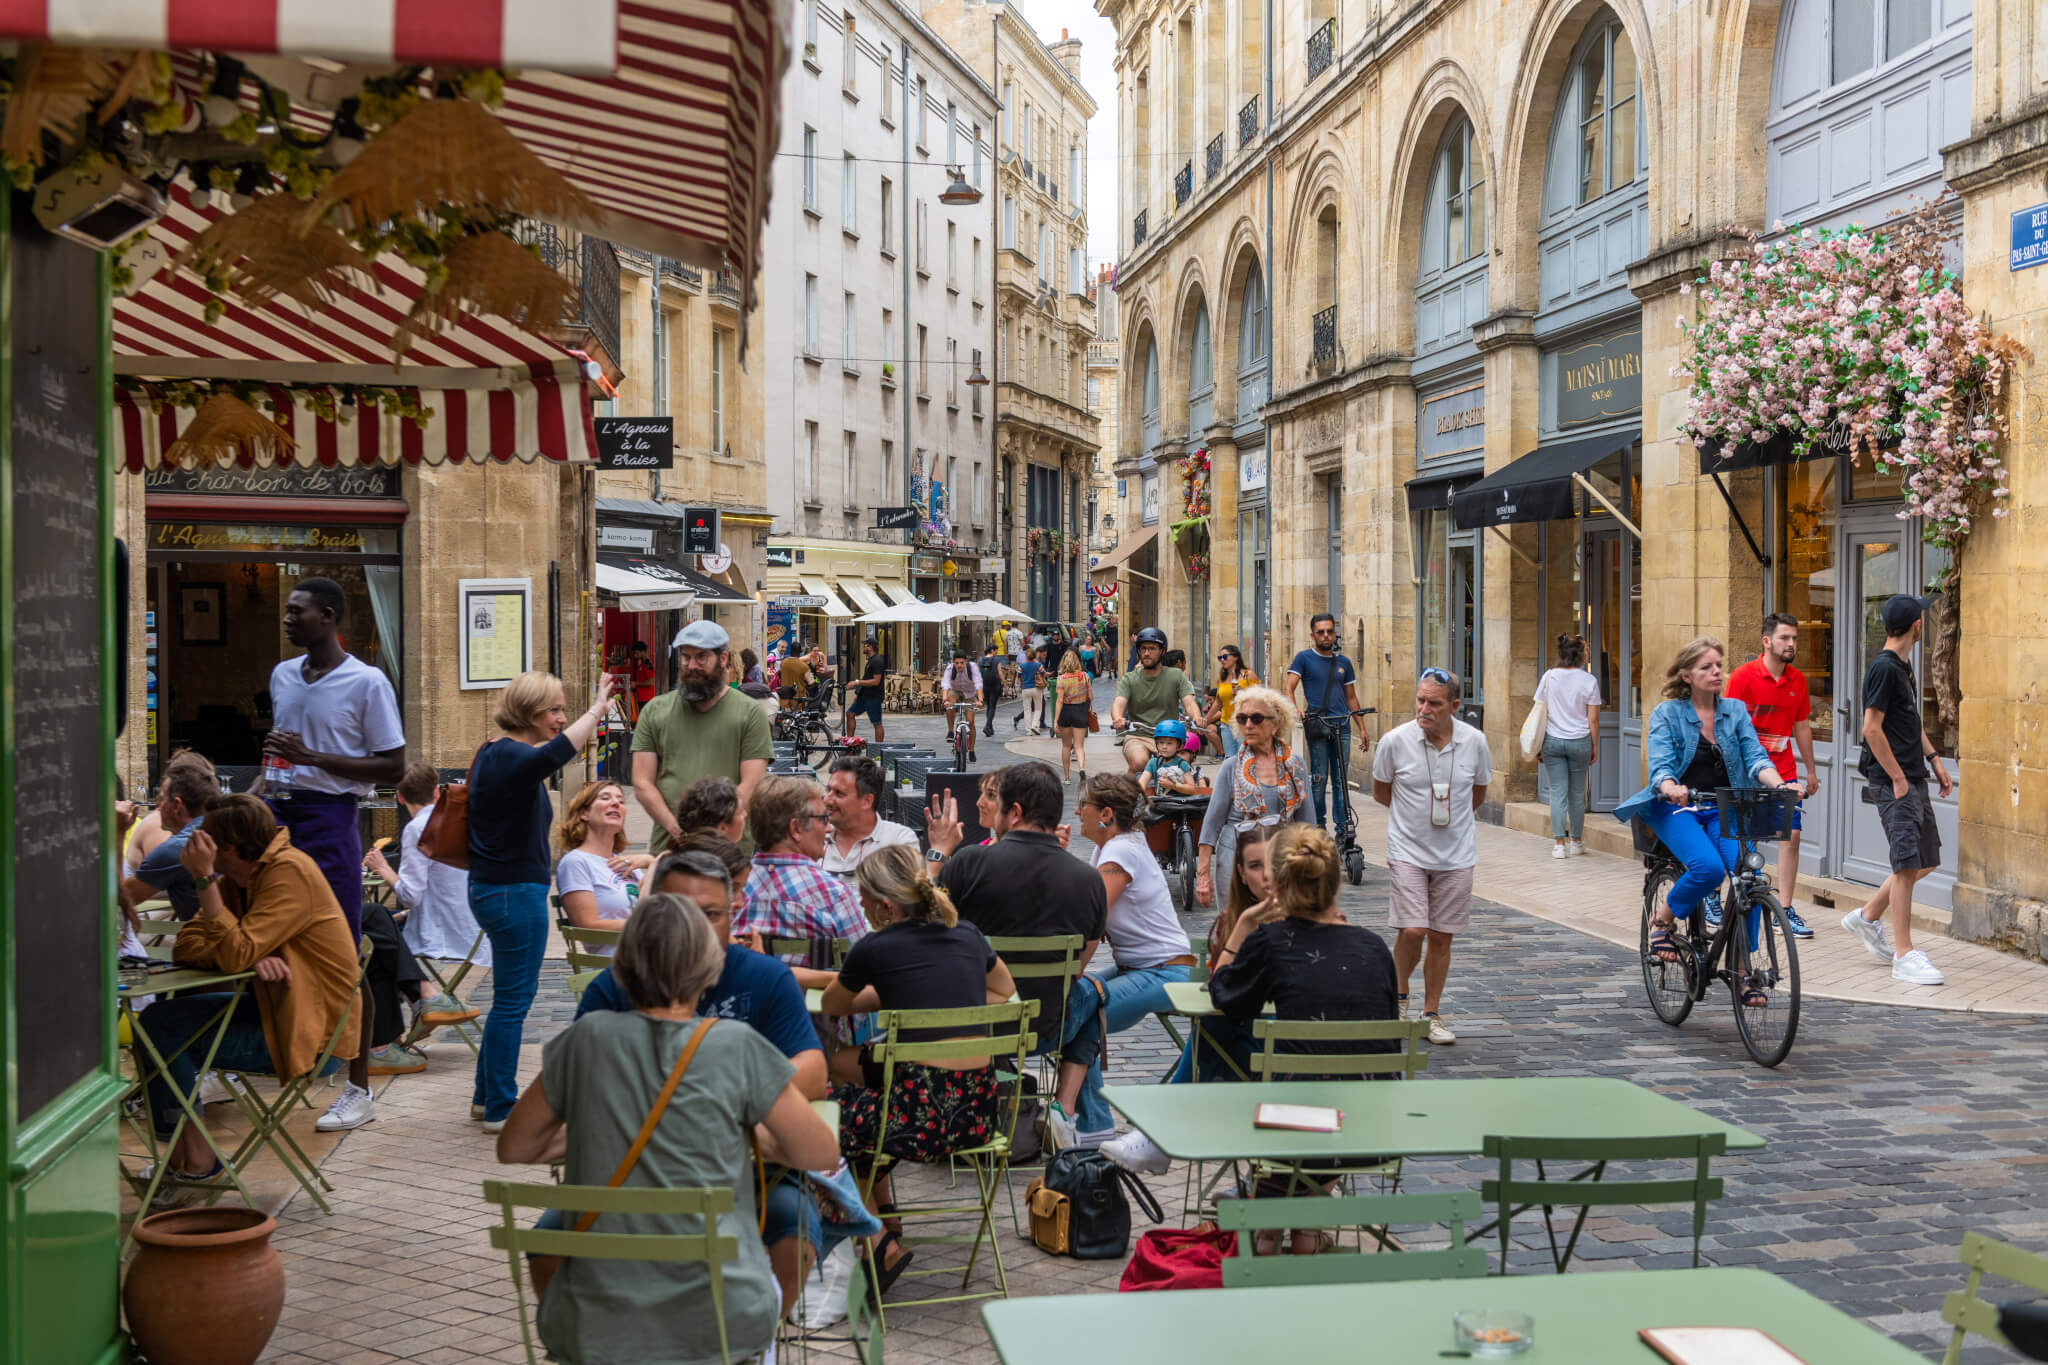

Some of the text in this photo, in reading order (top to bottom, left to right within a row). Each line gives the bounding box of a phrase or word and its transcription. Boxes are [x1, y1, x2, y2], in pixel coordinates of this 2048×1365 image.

[2032, 211, 2048, 228] RUE
[2034, 229, 2045, 240] DU
[1608, 352, 1641, 382] MARA
[601, 422, 669, 438] L'Agneau
[1436, 410, 1463, 435] BLACK
[621, 437, 650, 450] à la
[612, 453, 659, 466] Braise
[186, 466, 293, 492] charbon
[301, 468, 331, 490] de
[340, 473, 384, 494] bois
[157, 524, 249, 549] l'Agneau
[303, 528, 366, 548] Braise
